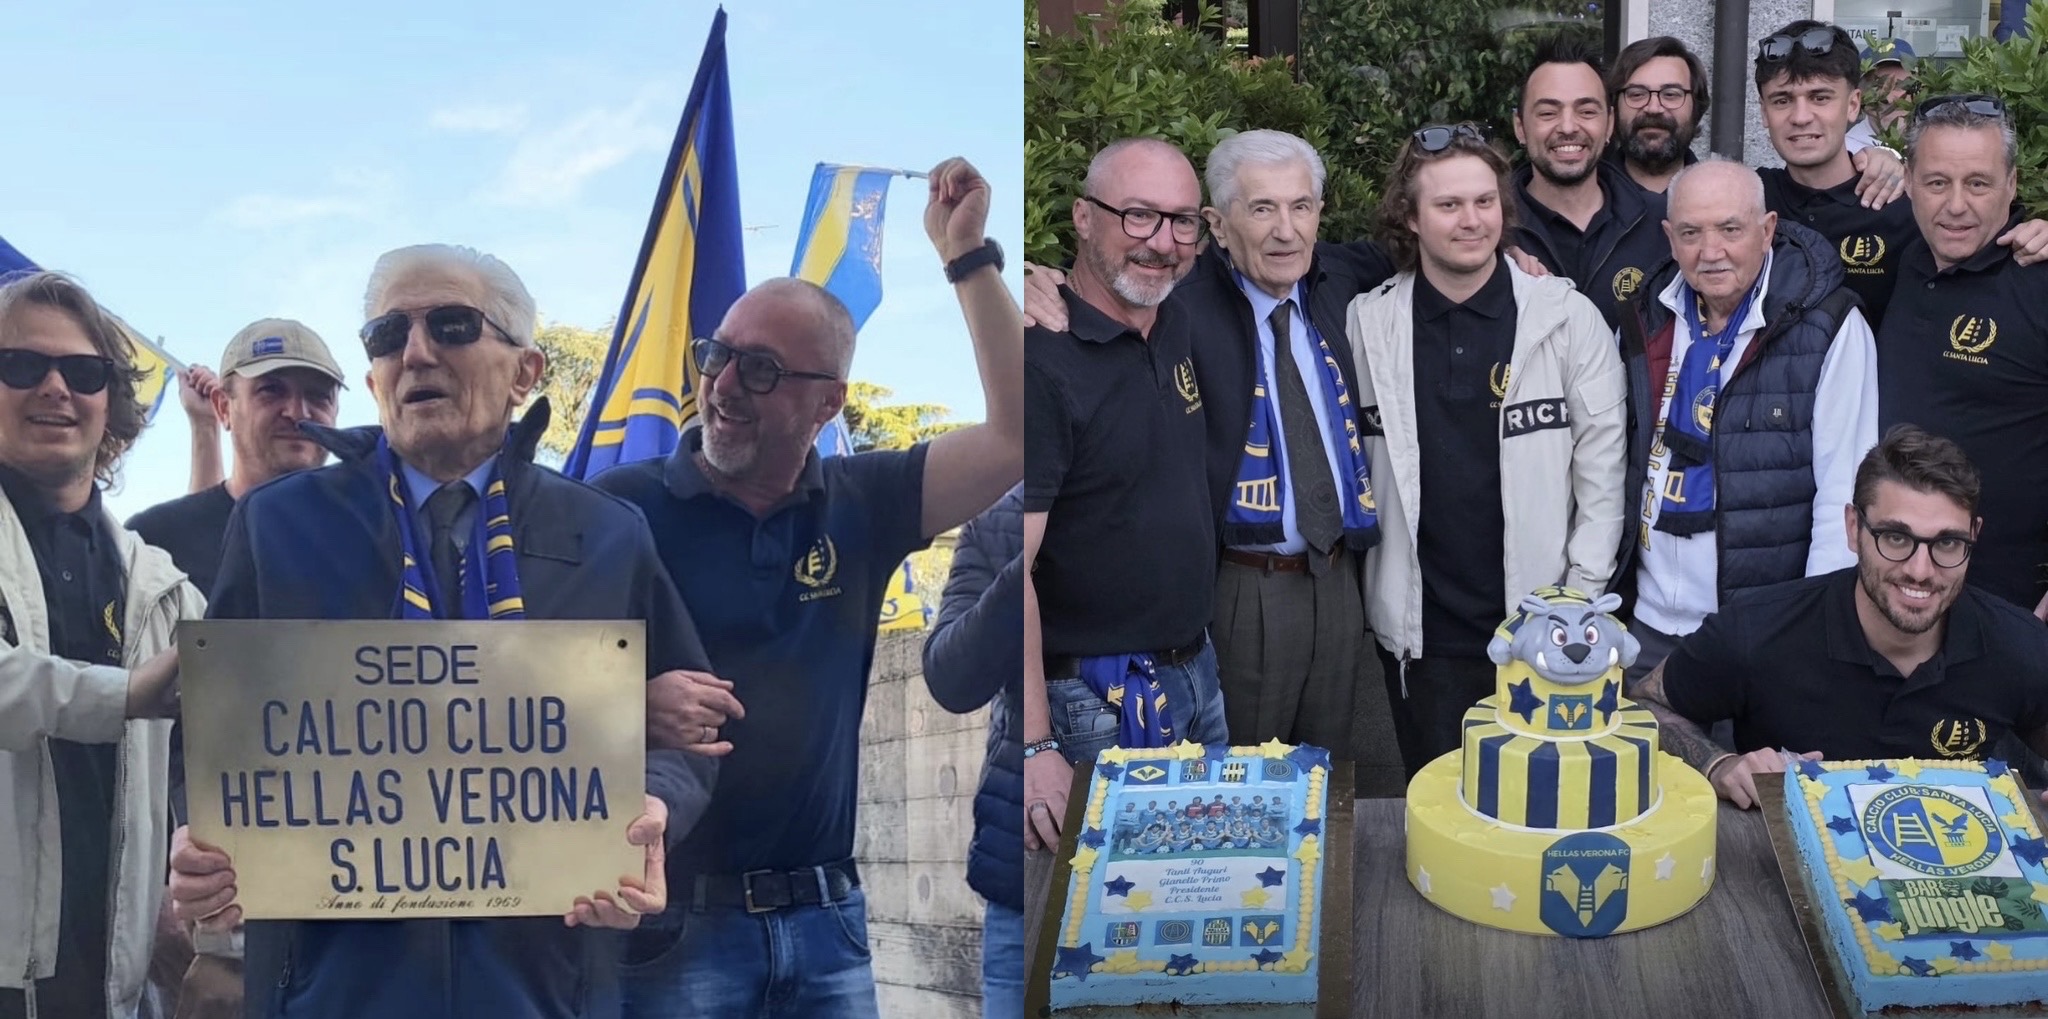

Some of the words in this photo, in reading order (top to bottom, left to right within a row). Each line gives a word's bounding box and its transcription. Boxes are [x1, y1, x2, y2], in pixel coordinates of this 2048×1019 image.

[354, 644, 480, 686] SEDE
[263, 698, 429, 757] CALCIO
[446, 696, 567, 754] CLUB
[220, 769, 405, 829] HELLAS
[427, 766, 609, 825] VERONA
[1866, 799, 1886, 834] CALCIO
[1884, 787, 1917, 801] CLUB
[1922, 788, 1967, 808] SANTA
[1968, 806, 1997, 833] LUCIA
[1547, 850, 1580, 858] HELLAS
[1580, 849, 1617, 857] VERONA
[1618, 848, 1630, 856] FC
[1192, 866, 1228, 876] Auguri
[1889, 852, 1945, 876] HELLAS
[1949, 851, 1997, 876] VERONA
[1201, 875, 1231, 884] Primo
[1904, 879, 1943, 898] BAR
[1169, 886, 1220, 895] Presidente
[1197, 895, 1222, 904] Lucia
[316, 894, 362, 910] Anno
[369, 895, 384, 910] di
[486, 897, 522, 909] 1969
[1896, 889, 2005, 935] jungle
